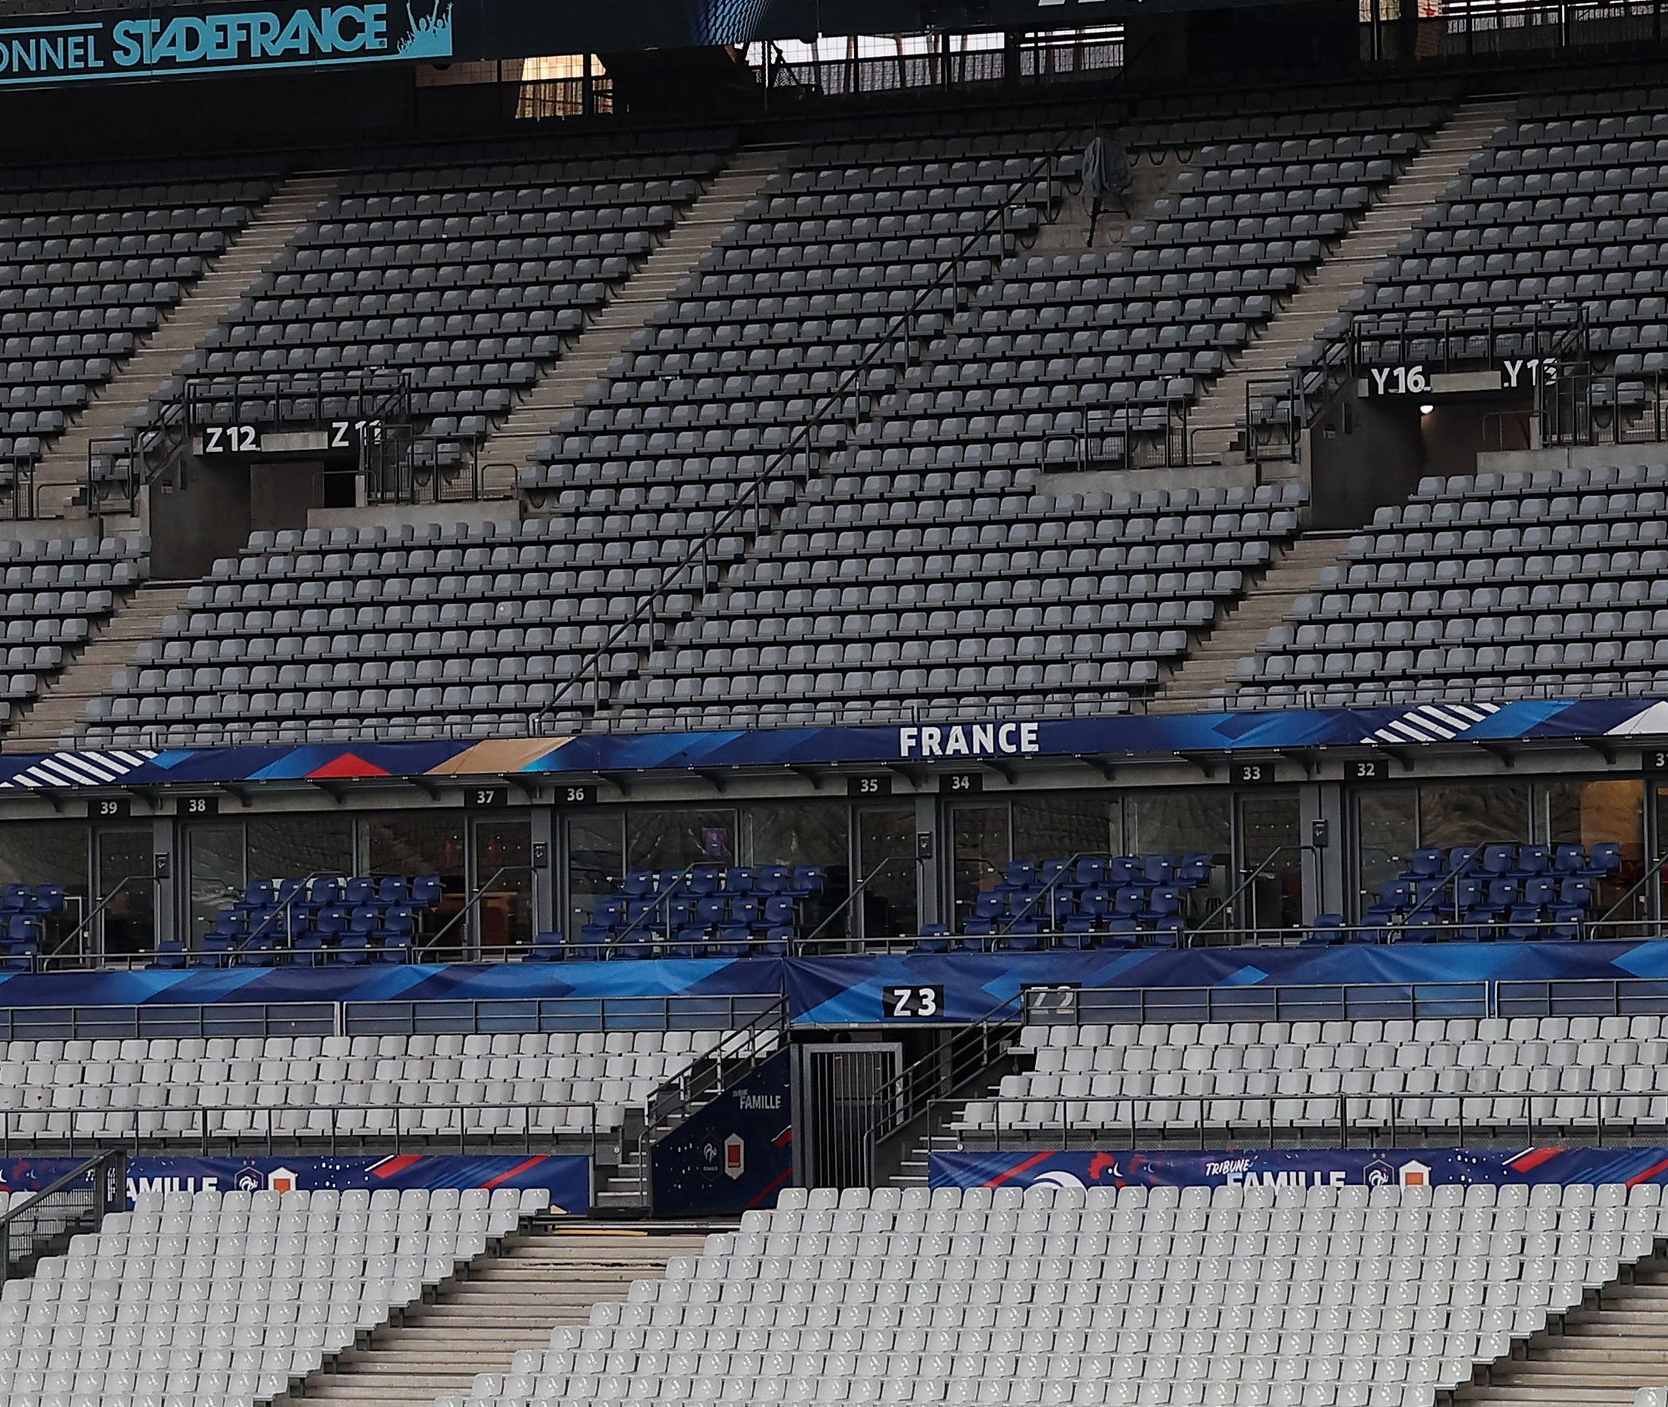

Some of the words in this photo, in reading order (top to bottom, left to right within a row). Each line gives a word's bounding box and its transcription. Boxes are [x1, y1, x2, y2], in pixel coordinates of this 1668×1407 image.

[1370, 365, 1426, 395] Y16
[205, 425, 257, 453] Z12
[900, 722, 1040, 757] FRANCE
[1243, 767, 1261, 780] 33
[1357, 763, 1375, 777] 32
[860, 779, 878, 792] 35
[952, 776, 970, 790] 34
[477, 790, 494, 804] 37
[567, 788, 584, 801] 36
[100, 802, 118, 815] 39
[189, 799, 206, 812] 38
[739, 1094, 781, 1110] FAMILLE
[1205, 1158, 1250, 1176] TRIBUNE
